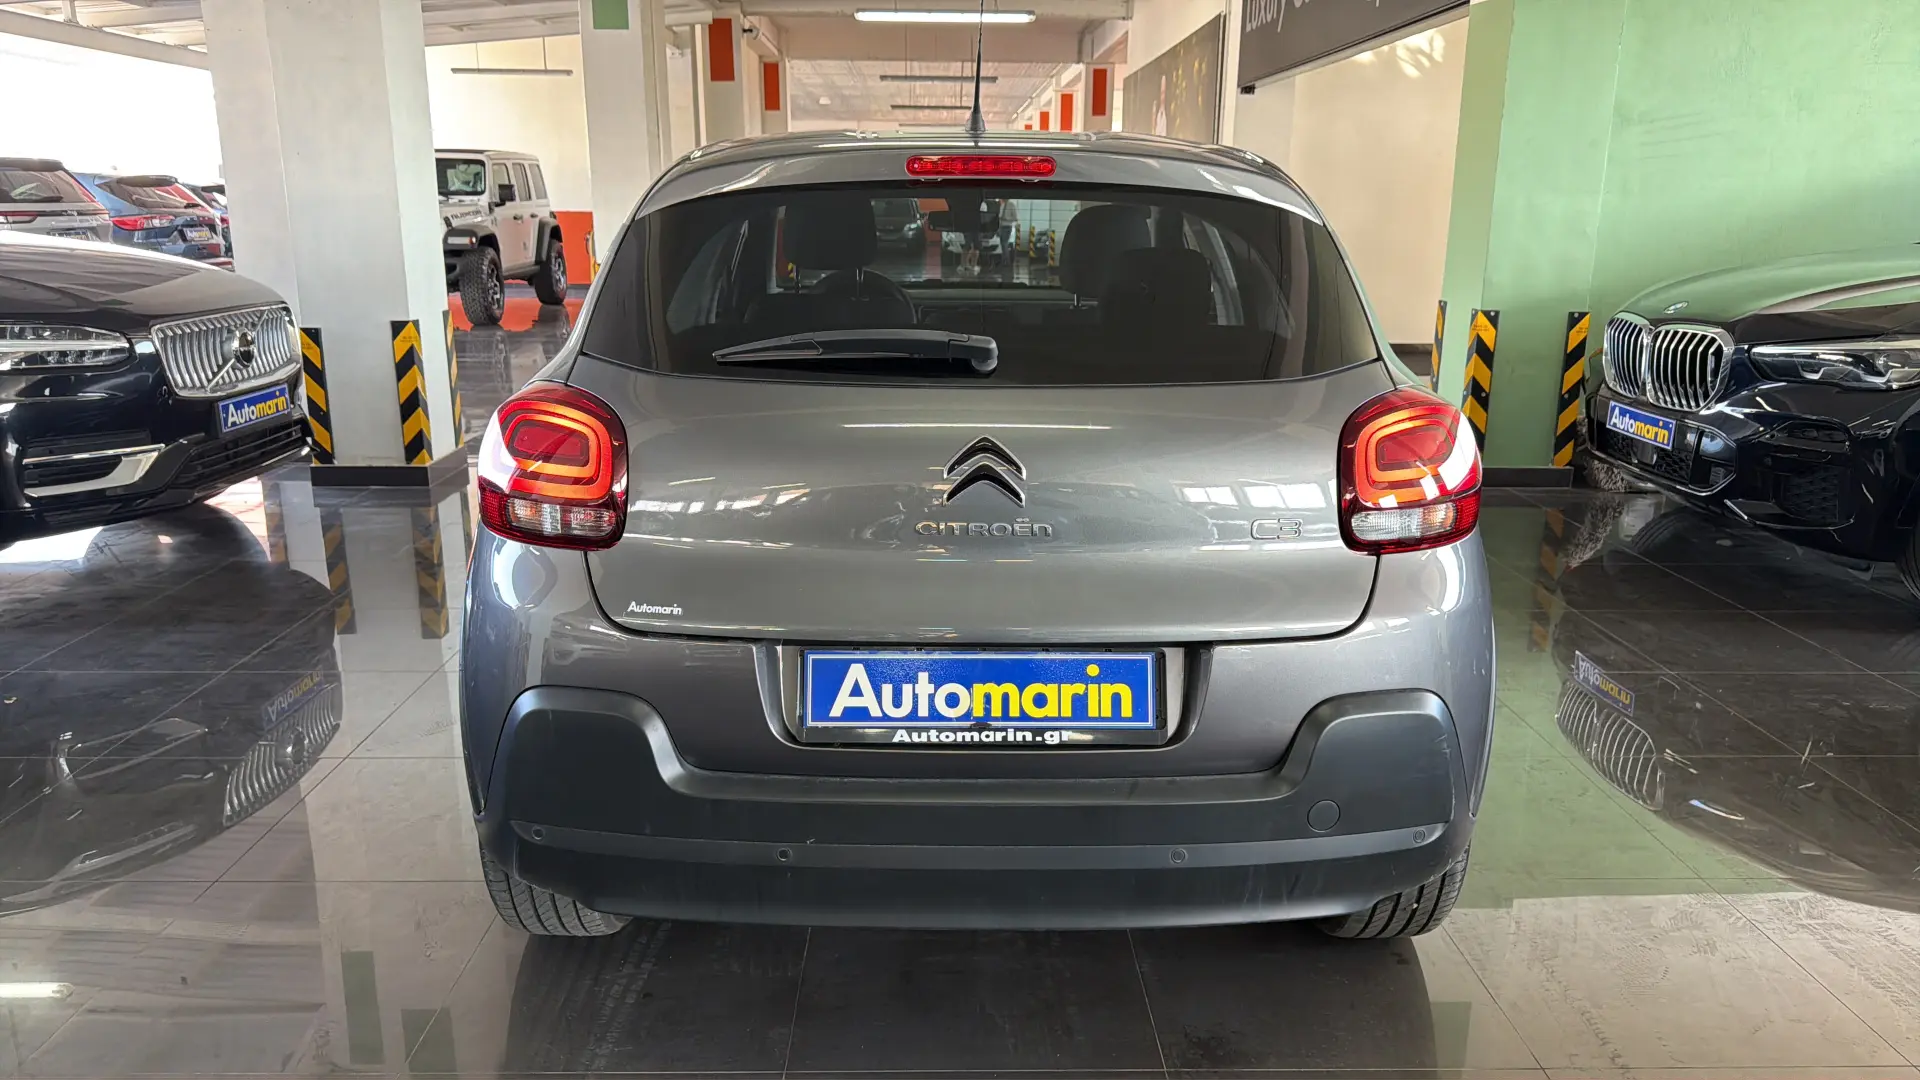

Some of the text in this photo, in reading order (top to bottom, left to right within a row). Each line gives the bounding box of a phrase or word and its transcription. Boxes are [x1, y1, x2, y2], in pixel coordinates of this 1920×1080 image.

[227, 390, 287, 428] Automarin
[1610, 406, 1669, 445] Automarin
[1250, 518, 1303, 540] C3
[627, 601, 682, 615] Automarin
[828, 663, 1133, 718] Automarin
[892, 728, 1072, 745] Automarin.gr
